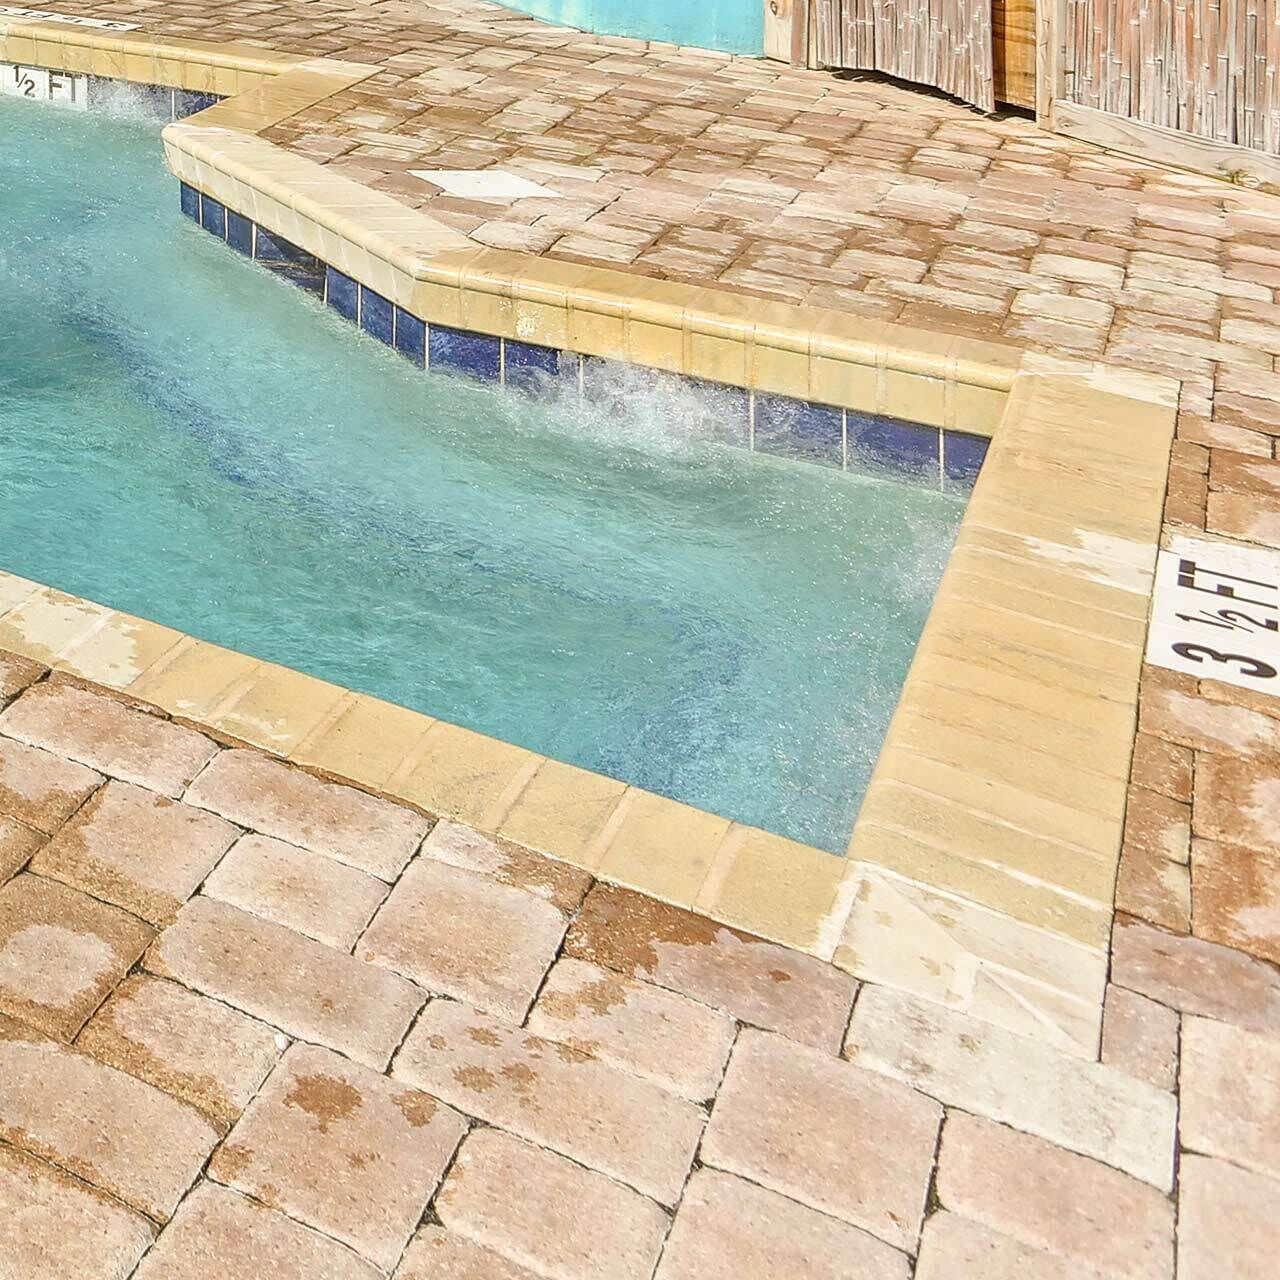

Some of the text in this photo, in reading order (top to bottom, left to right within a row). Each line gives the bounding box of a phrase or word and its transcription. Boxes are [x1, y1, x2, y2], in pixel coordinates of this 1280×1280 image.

[48, 69, 83, 104] FT
[1177, 559, 1279, 610] FT
[1171, 642, 1277, 679] 3
